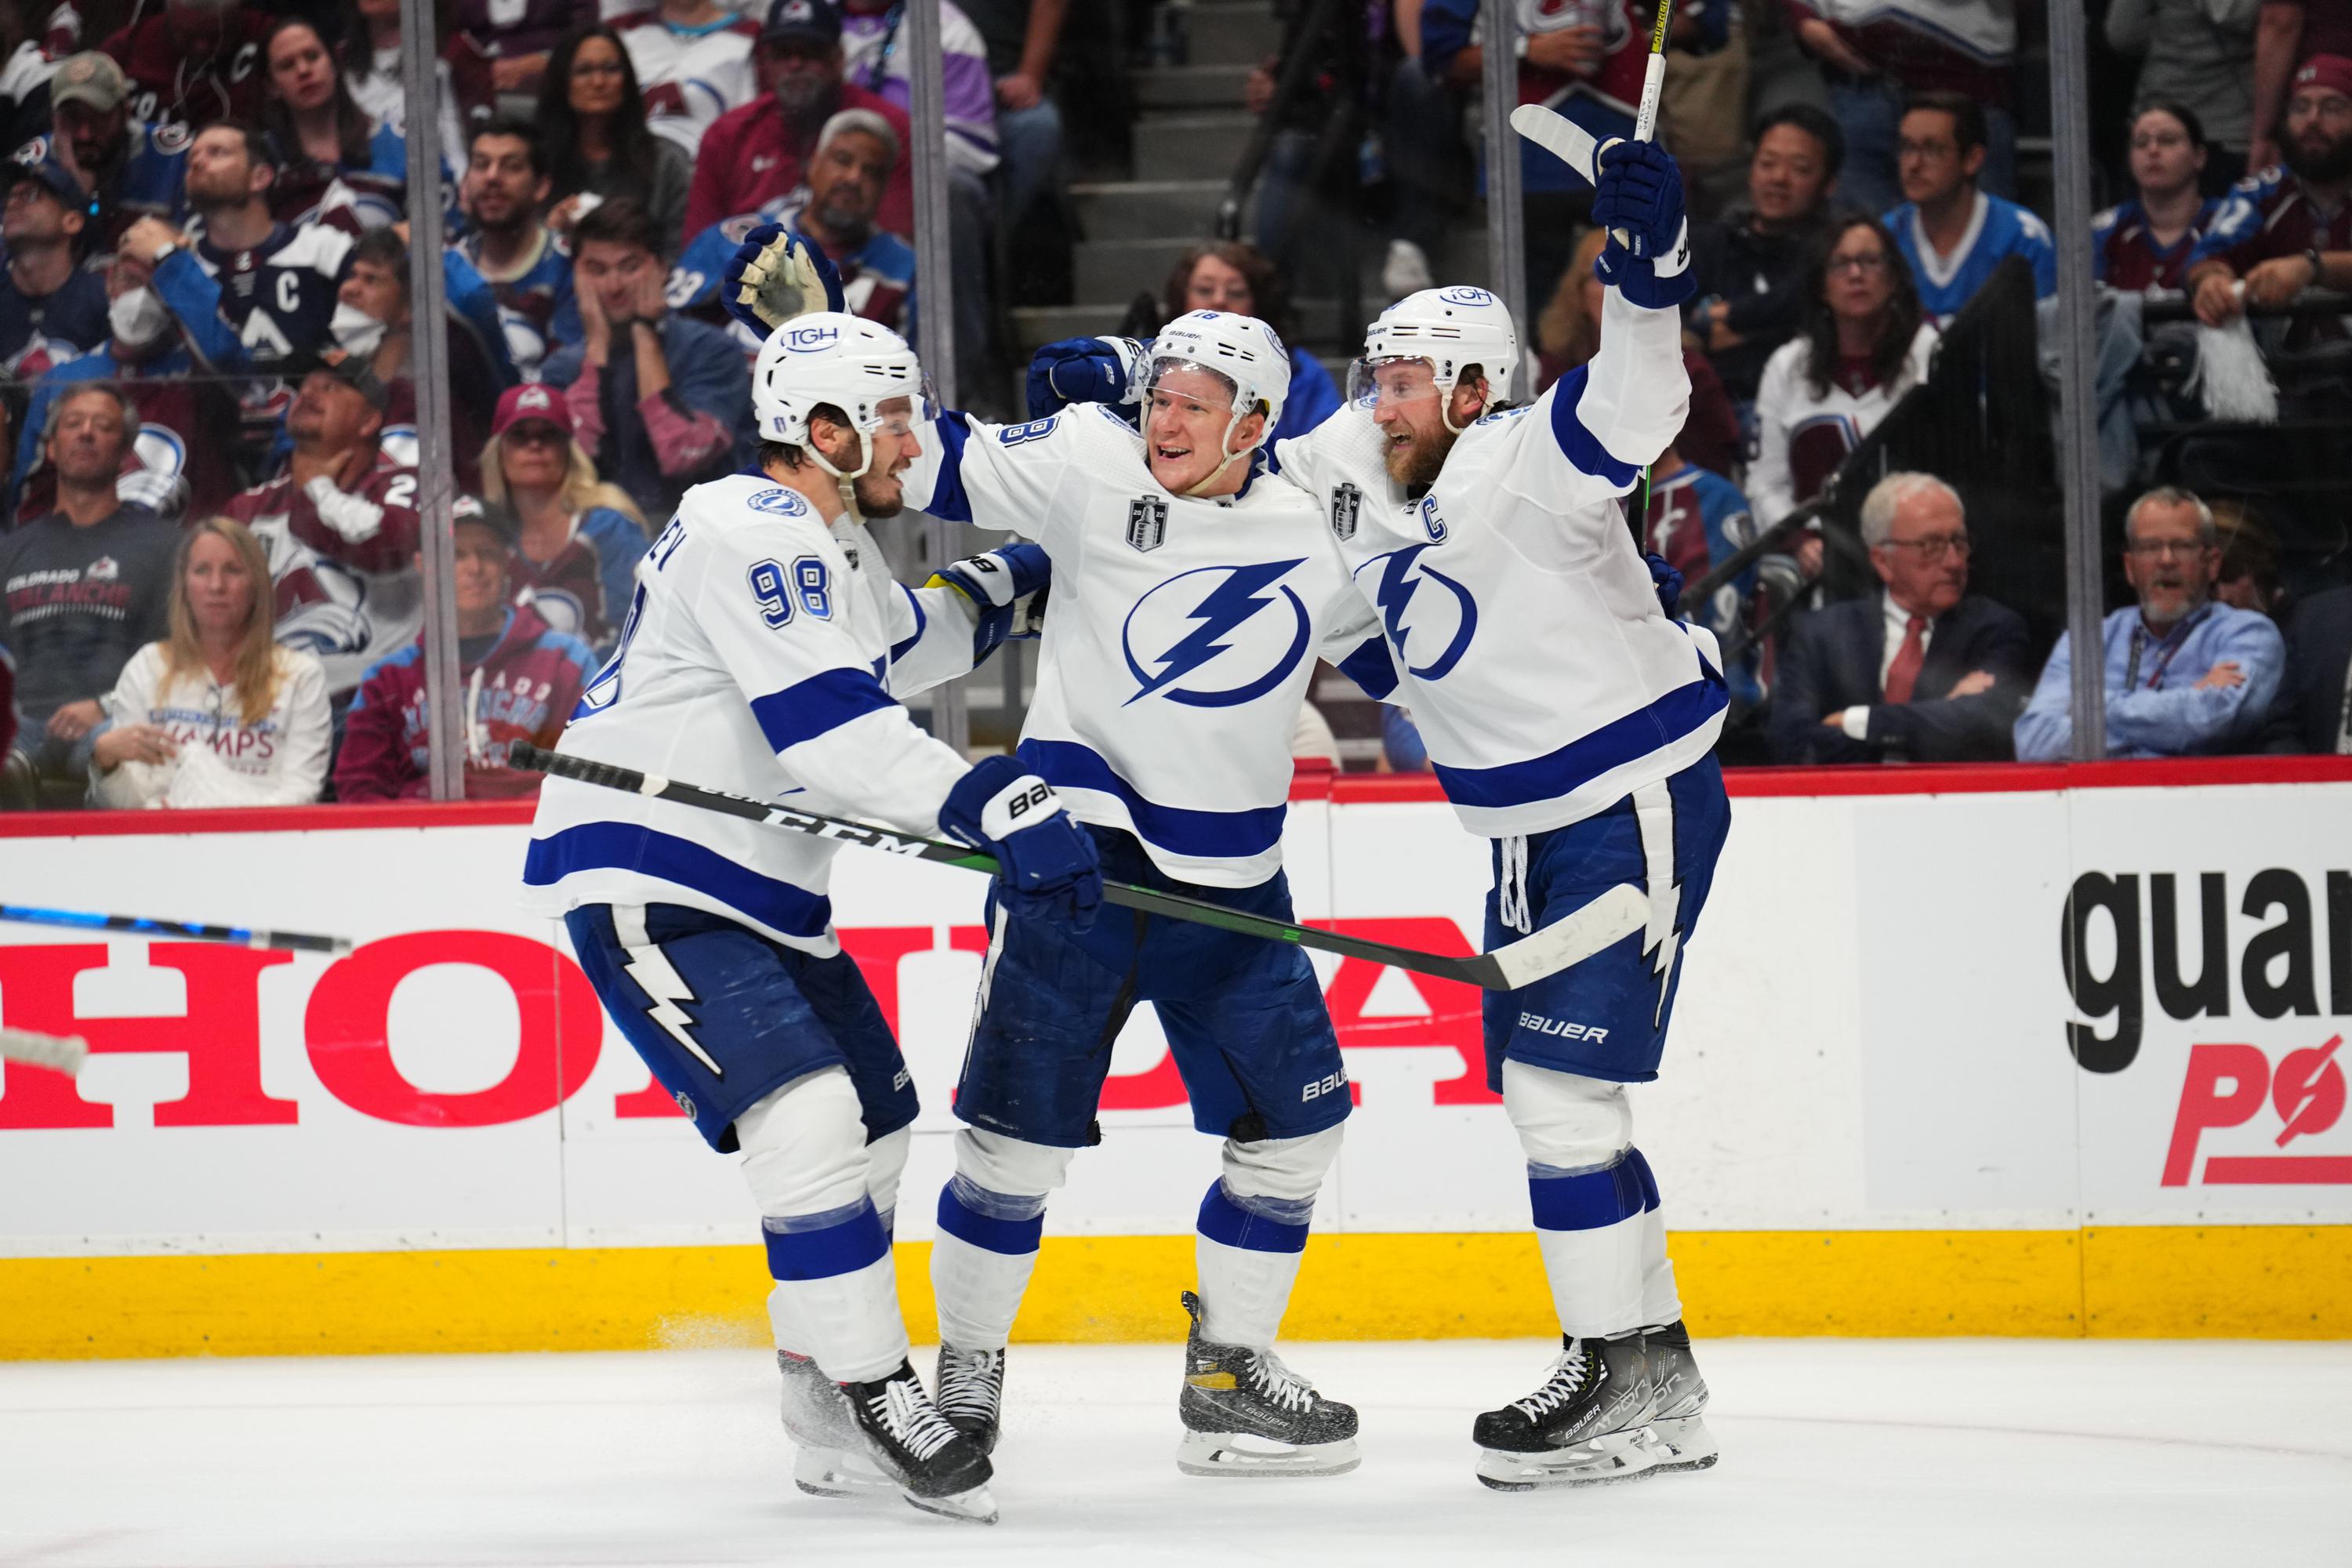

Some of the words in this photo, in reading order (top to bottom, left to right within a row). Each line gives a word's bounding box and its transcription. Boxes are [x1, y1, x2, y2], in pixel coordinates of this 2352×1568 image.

[276, 270, 300, 313] C
[789, 328, 838, 347] TGH
[1421, 494, 1448, 543] C
[746, 555, 833, 630] 98
[762, 808, 929, 858] CCM
[1518, 1011, 1609, 1044] BAUER
[1565, 1403, 1602, 1440] BAUER
